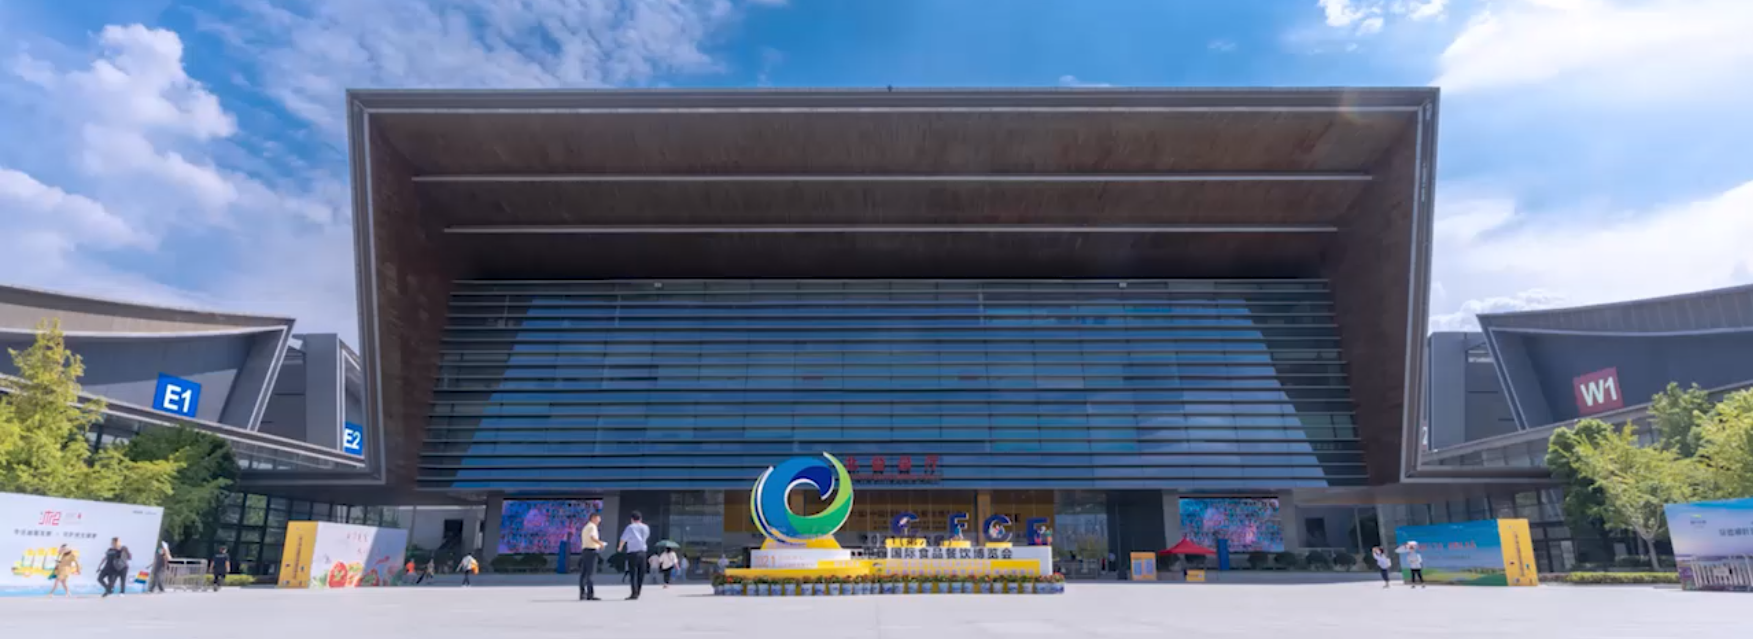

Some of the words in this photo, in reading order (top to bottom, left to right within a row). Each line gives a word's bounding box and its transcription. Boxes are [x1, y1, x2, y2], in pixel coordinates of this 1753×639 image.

[163, 384, 192, 413] E1
[1580, 376, 1617, 406] W1
[343, 429, 361, 450] E2
